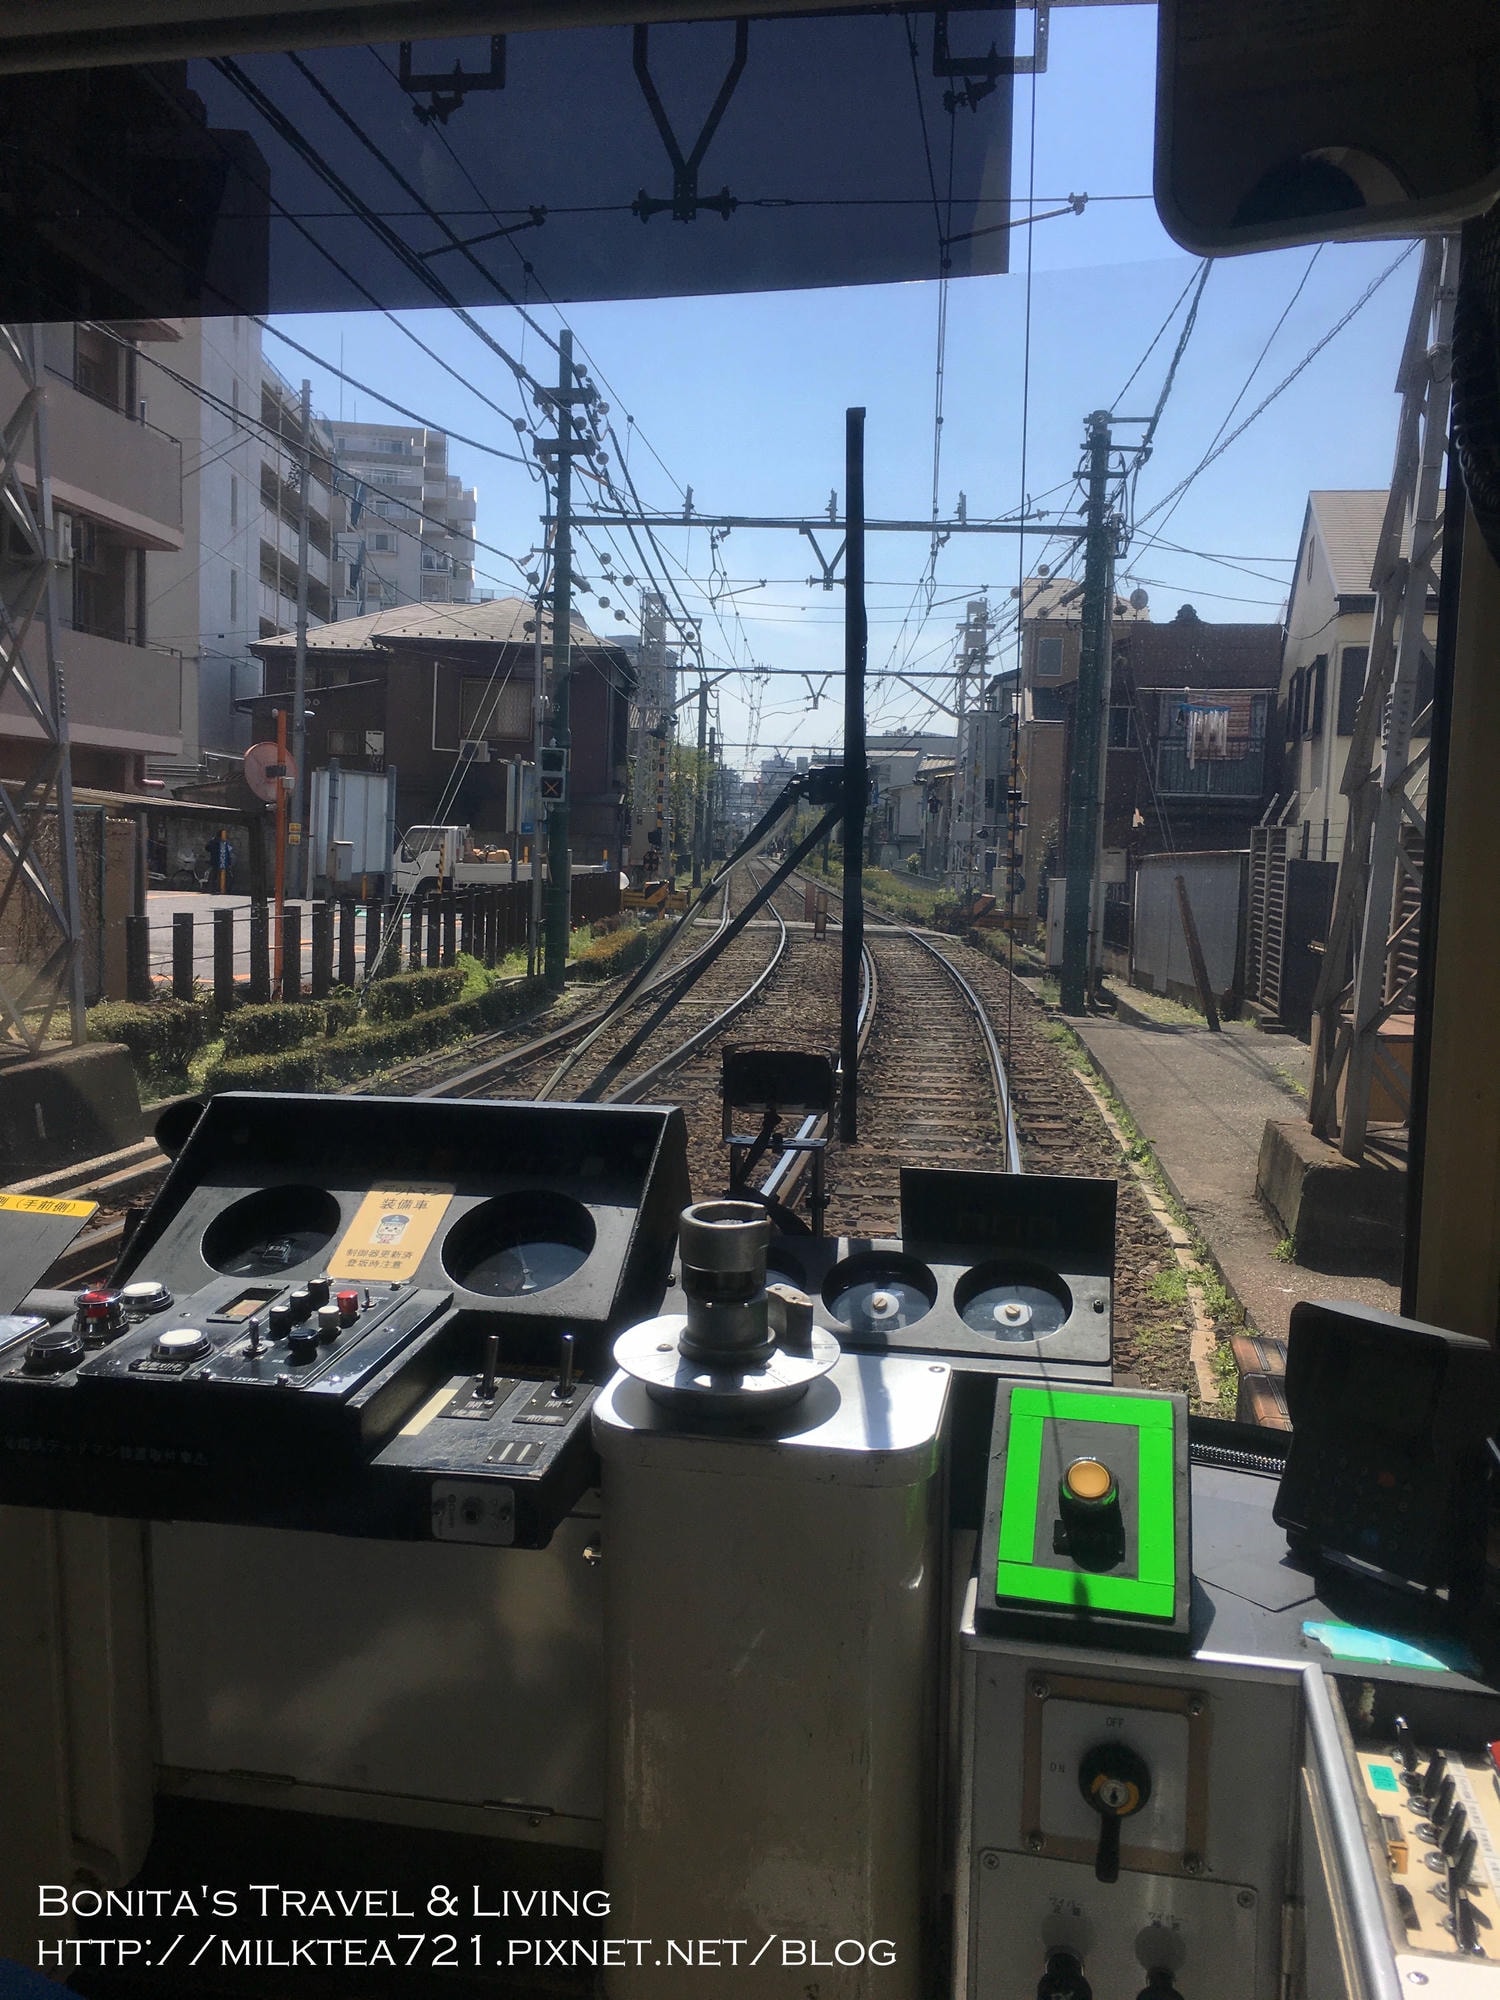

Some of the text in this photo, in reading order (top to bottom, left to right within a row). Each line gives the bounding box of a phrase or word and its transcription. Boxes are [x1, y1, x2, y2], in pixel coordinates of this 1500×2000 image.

[379, 1198, 430, 1210] 装備車
[1105, 1716, 1125, 1729] OFF
